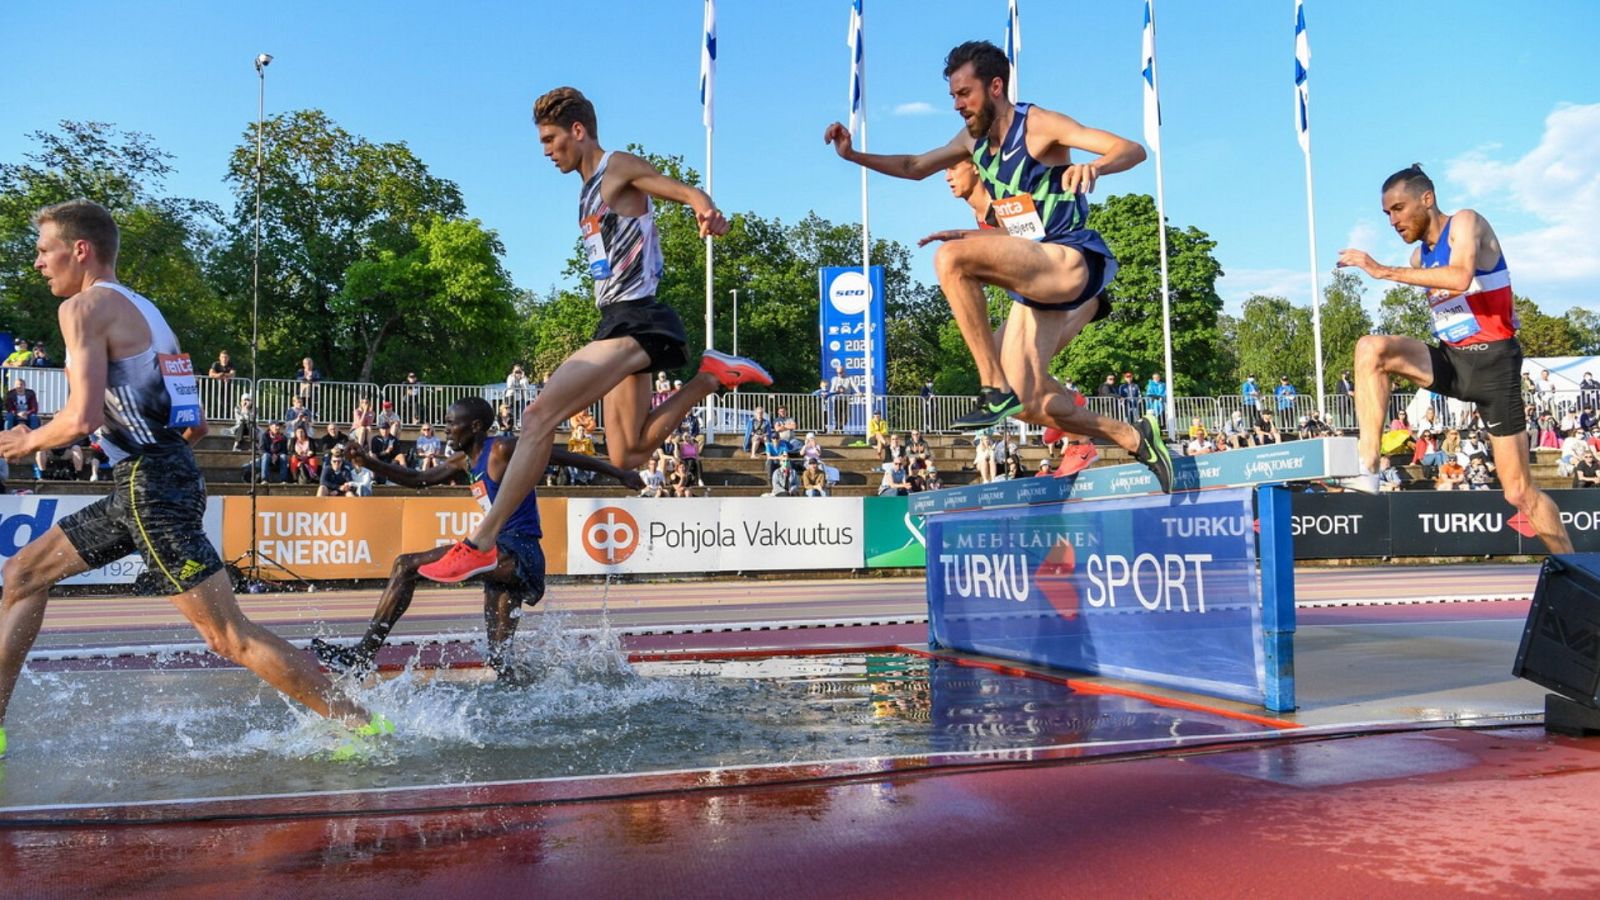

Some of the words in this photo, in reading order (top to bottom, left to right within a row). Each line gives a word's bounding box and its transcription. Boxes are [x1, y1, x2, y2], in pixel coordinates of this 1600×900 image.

[257, 511, 347, 537] TURKU
[435, 511, 485, 536] TUR
[1162, 516, 1246, 538] TURKU
[1291, 515, 1363, 535] SPORT
[1418, 512, 1503, 534] TURKU
[650, 521, 736, 553] Pohjola
[743, 519, 853, 547] Vakuutus
[257, 539, 372, 565] ENERGIA
[940, 554, 1029, 602] TURKU
[1087, 552, 1213, 614] SPORT
